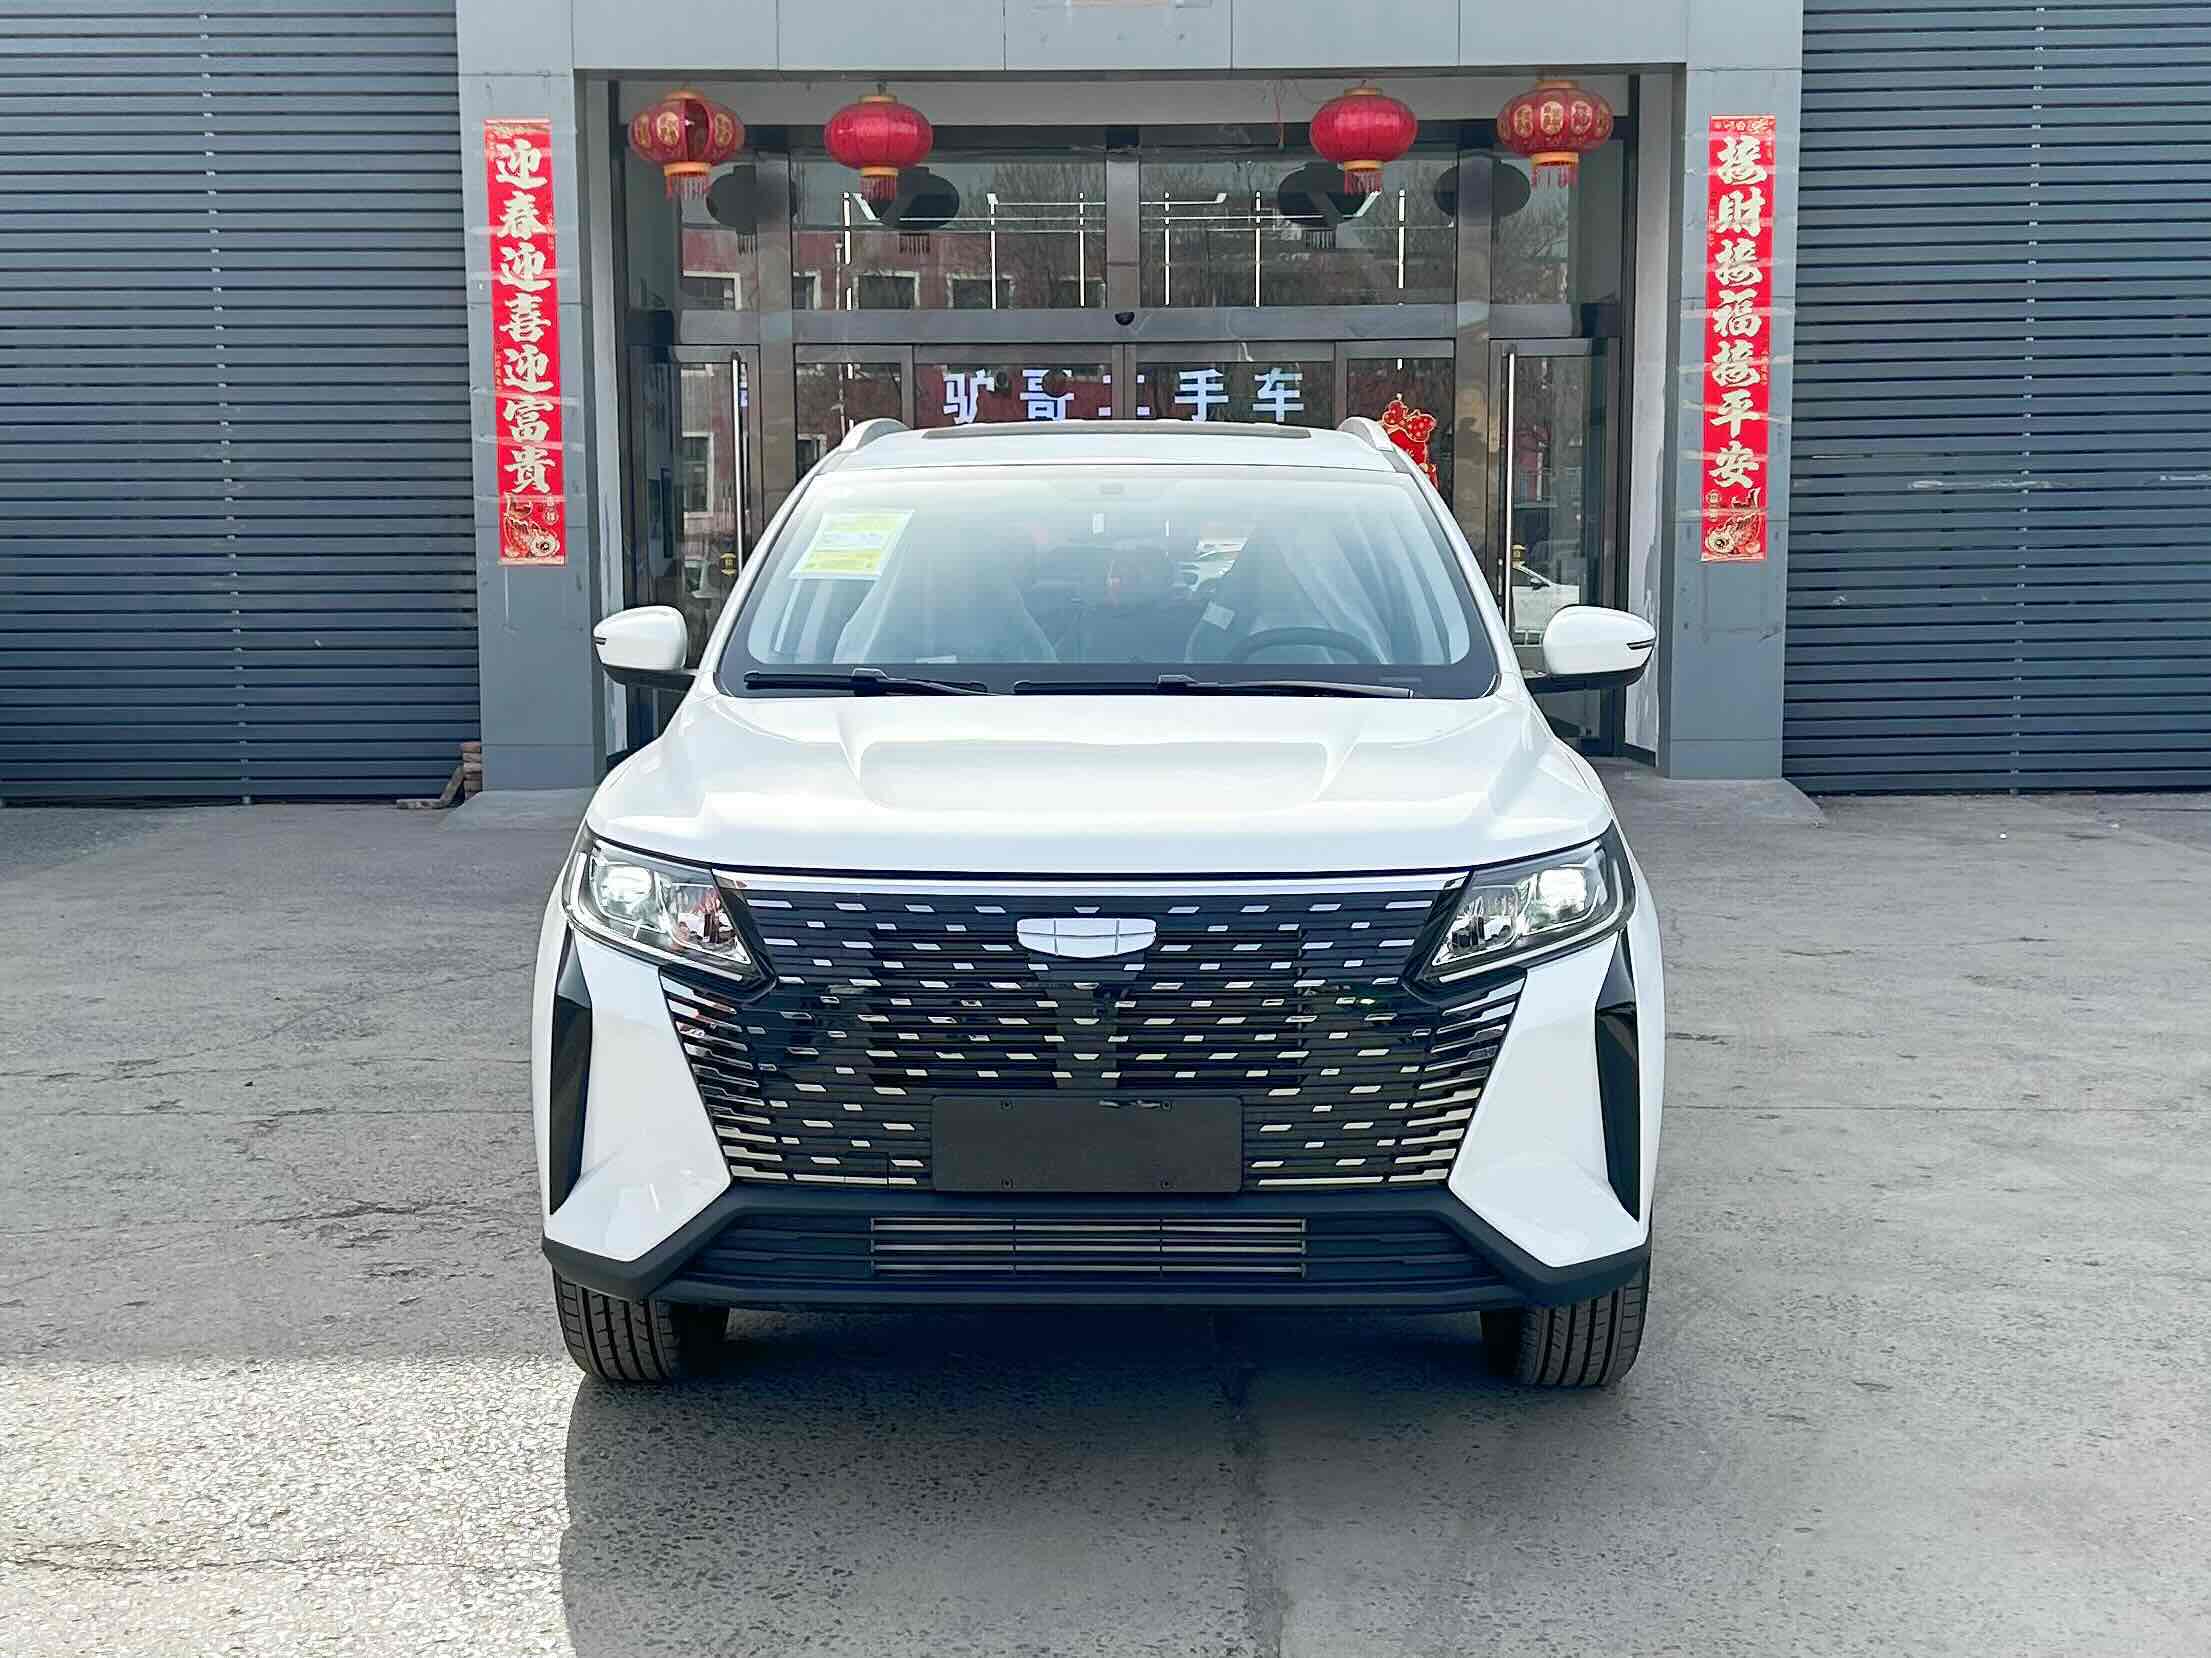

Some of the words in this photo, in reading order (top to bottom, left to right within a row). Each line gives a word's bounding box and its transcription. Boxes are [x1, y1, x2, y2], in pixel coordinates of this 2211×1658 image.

[495, 138, 556, 494] 迎春迎喜迎富貴
[1709, 134, 1768, 489] 接財接福接平安
